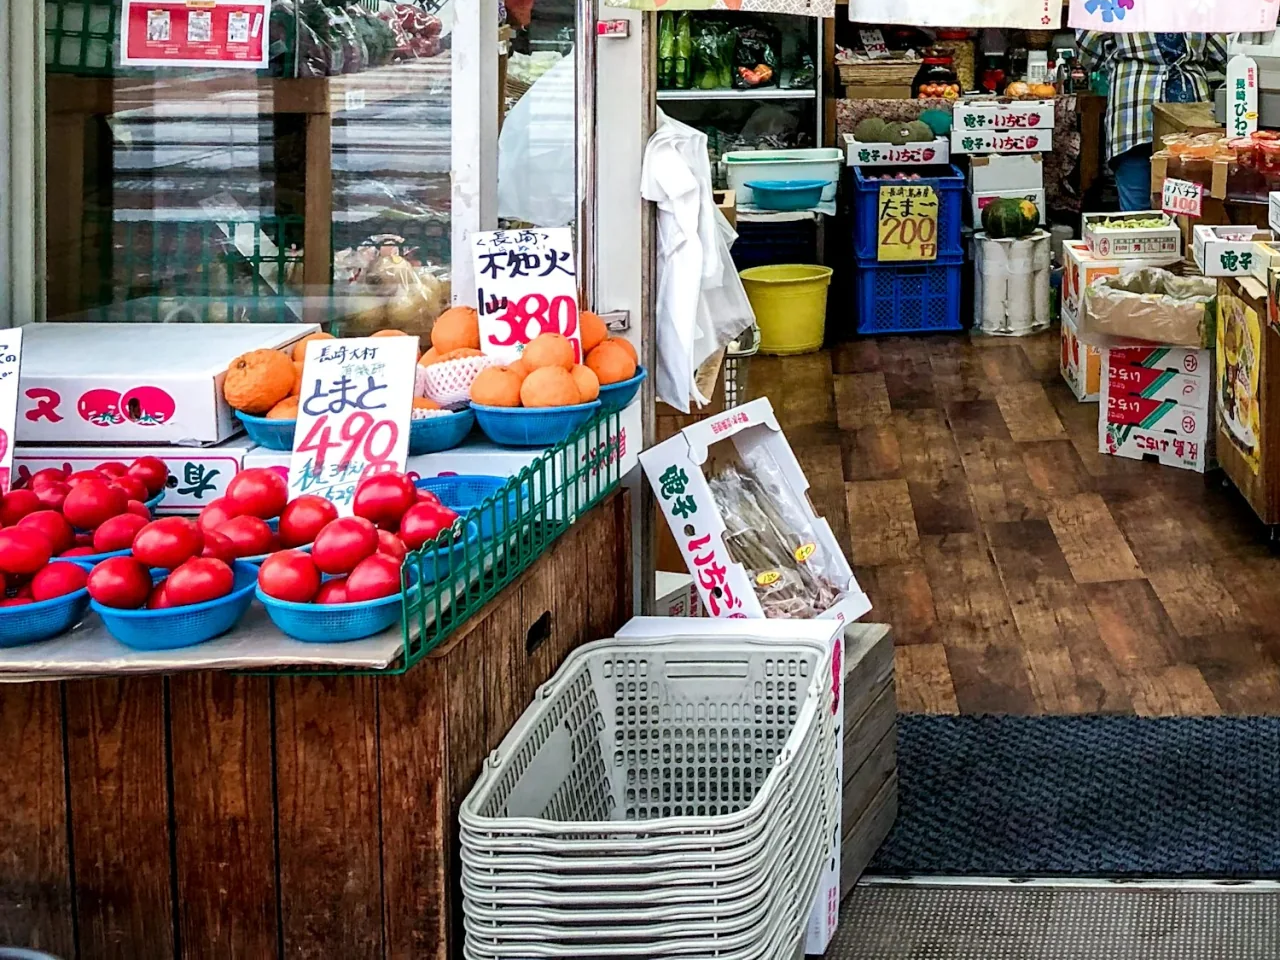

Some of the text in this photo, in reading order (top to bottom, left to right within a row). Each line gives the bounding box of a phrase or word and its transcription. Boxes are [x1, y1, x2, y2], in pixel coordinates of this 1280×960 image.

[880, 198, 937, 220] たまご
[881, 217, 936, 257] 200 円
[478, 248, 576, 279] 不知火
[1220, 251, 1252, 271] 電子
[488, 293, 577, 346] 380
[303, 375, 388, 416] とまと
[296, 411, 400, 477] 490
